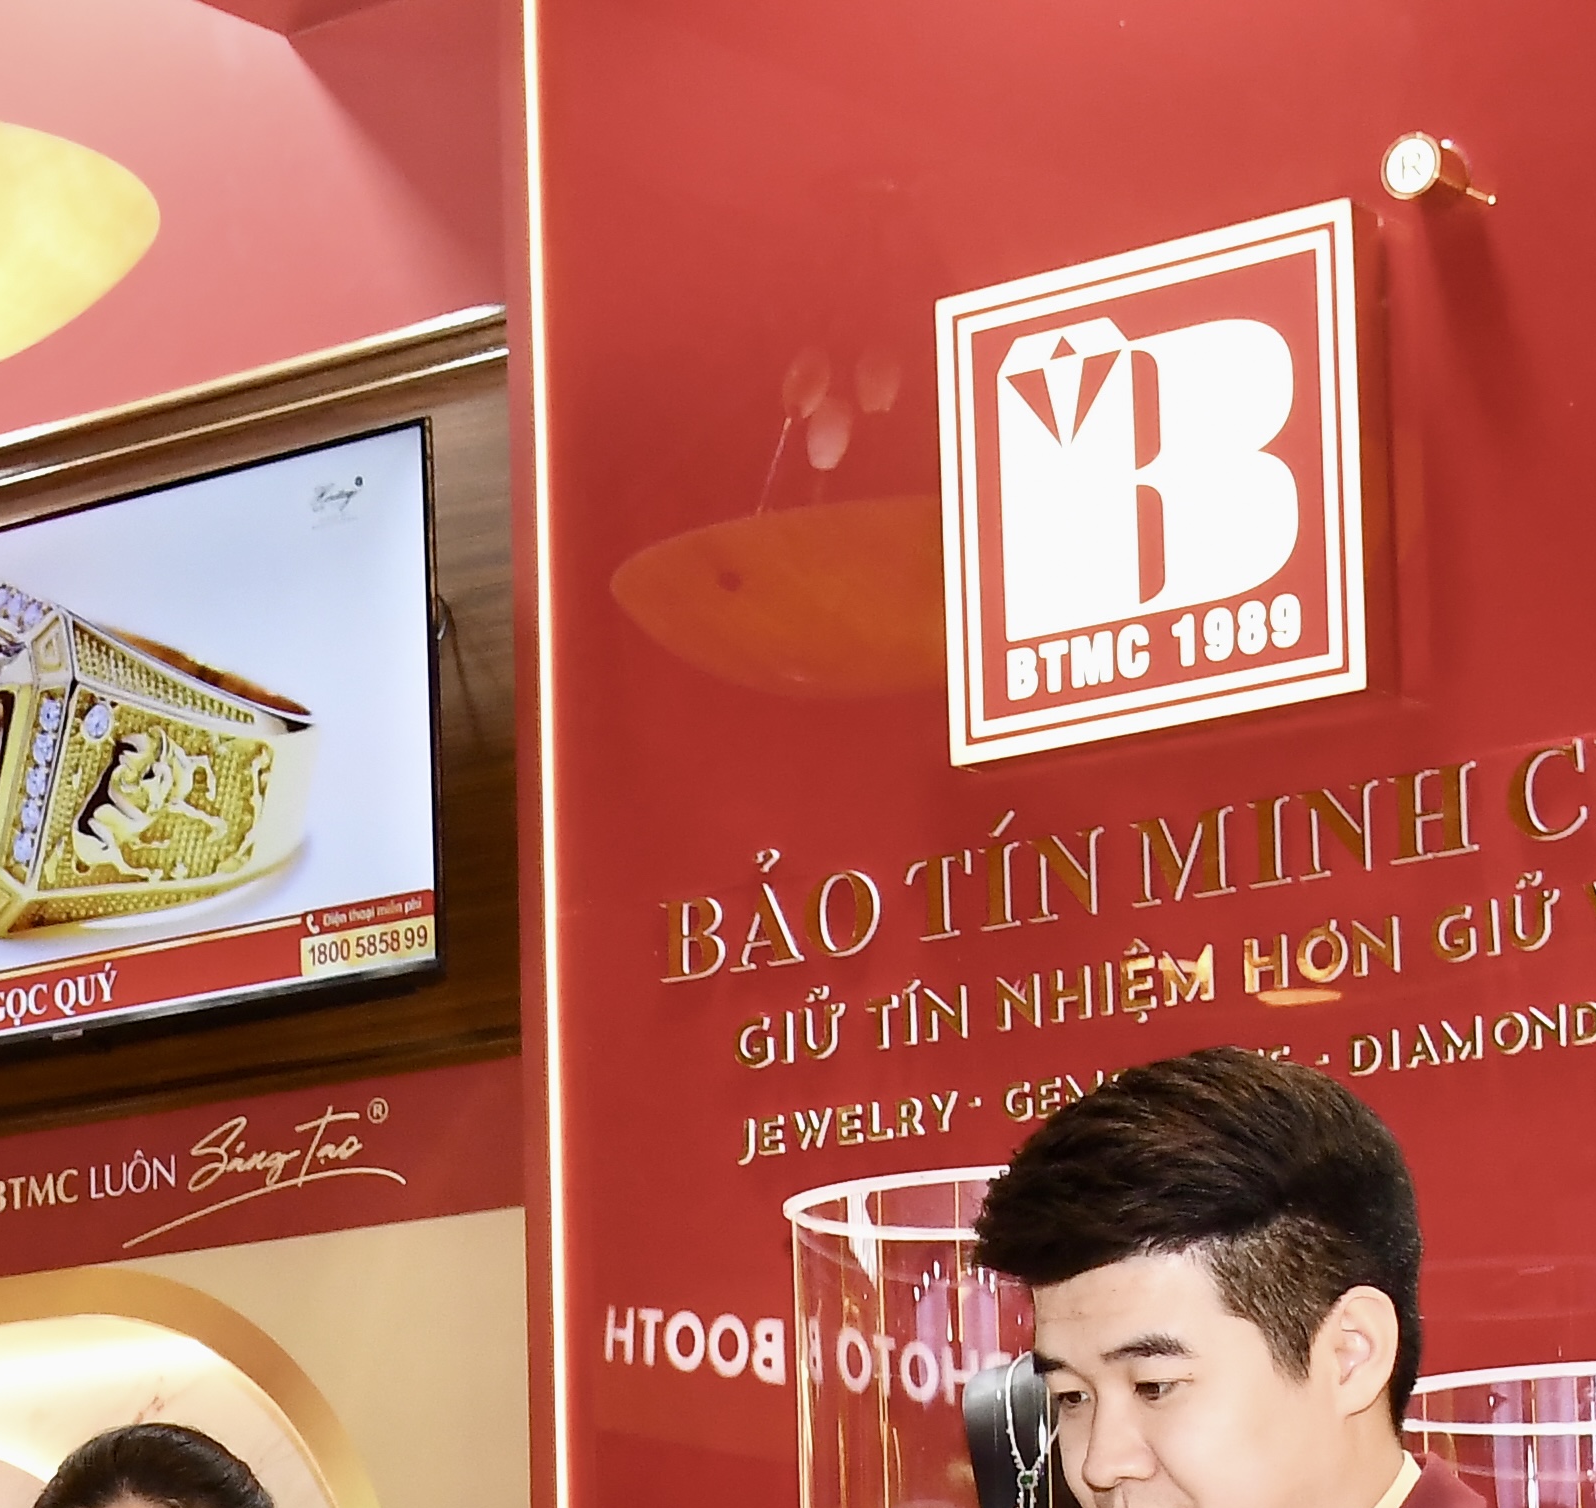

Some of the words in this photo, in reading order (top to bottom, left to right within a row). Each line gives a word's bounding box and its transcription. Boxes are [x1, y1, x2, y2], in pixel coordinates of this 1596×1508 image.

[1004, 619, 1151, 704] BTMC
[1170, 592, 1303, 680] 1989
[658, 847, 884, 985] BẢO
[904, 810, 1106, 943] TÍN
[1129, 760, 1480, 908] MINH
[54, 963, 118, 1015] QUÝ
[308, 938, 351, 966] 1800
[734, 985, 846, 1069] GIỮ
[866, 978, 969, 1051] TÍN
[996, 938, 1216, 1032] NHIỆM
[1243, 915, 1401, 994] HƠN
[1433, 870, 1561, 963] GIỮ
[737, 1090, 960, 1165] JEWELRY
[89, 1149, 177, 1200] LUÔN
